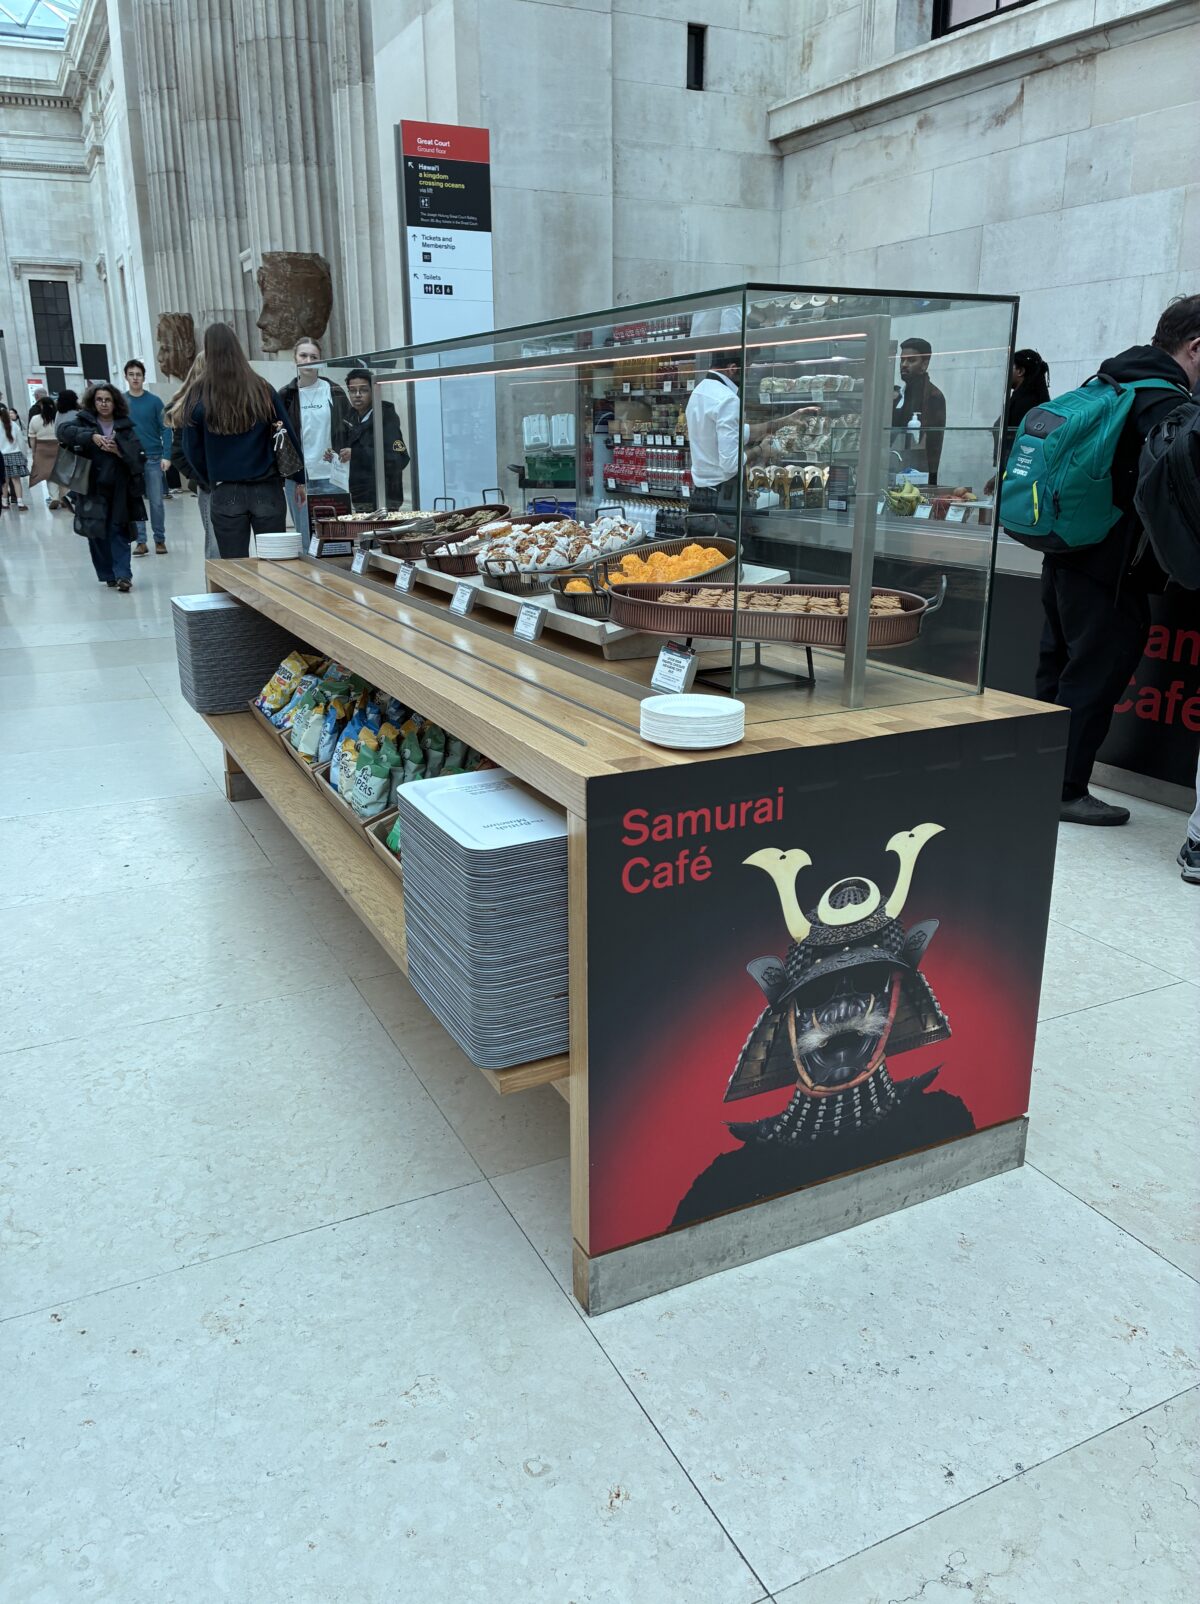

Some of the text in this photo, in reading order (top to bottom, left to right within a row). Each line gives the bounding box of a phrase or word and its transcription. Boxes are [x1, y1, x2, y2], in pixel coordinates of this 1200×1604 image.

[417, 137, 450, 147] Great Court
[417, 145, 435, 154] Ground
[424, 171, 449, 180] kingdom
[419, 180, 443, 188] crossing
[422, 241, 456, 250] Membership
[423, 273, 441, 281] Toilets
[621, 786, 784, 847] Samurai
[621, 845, 713, 894] Café
